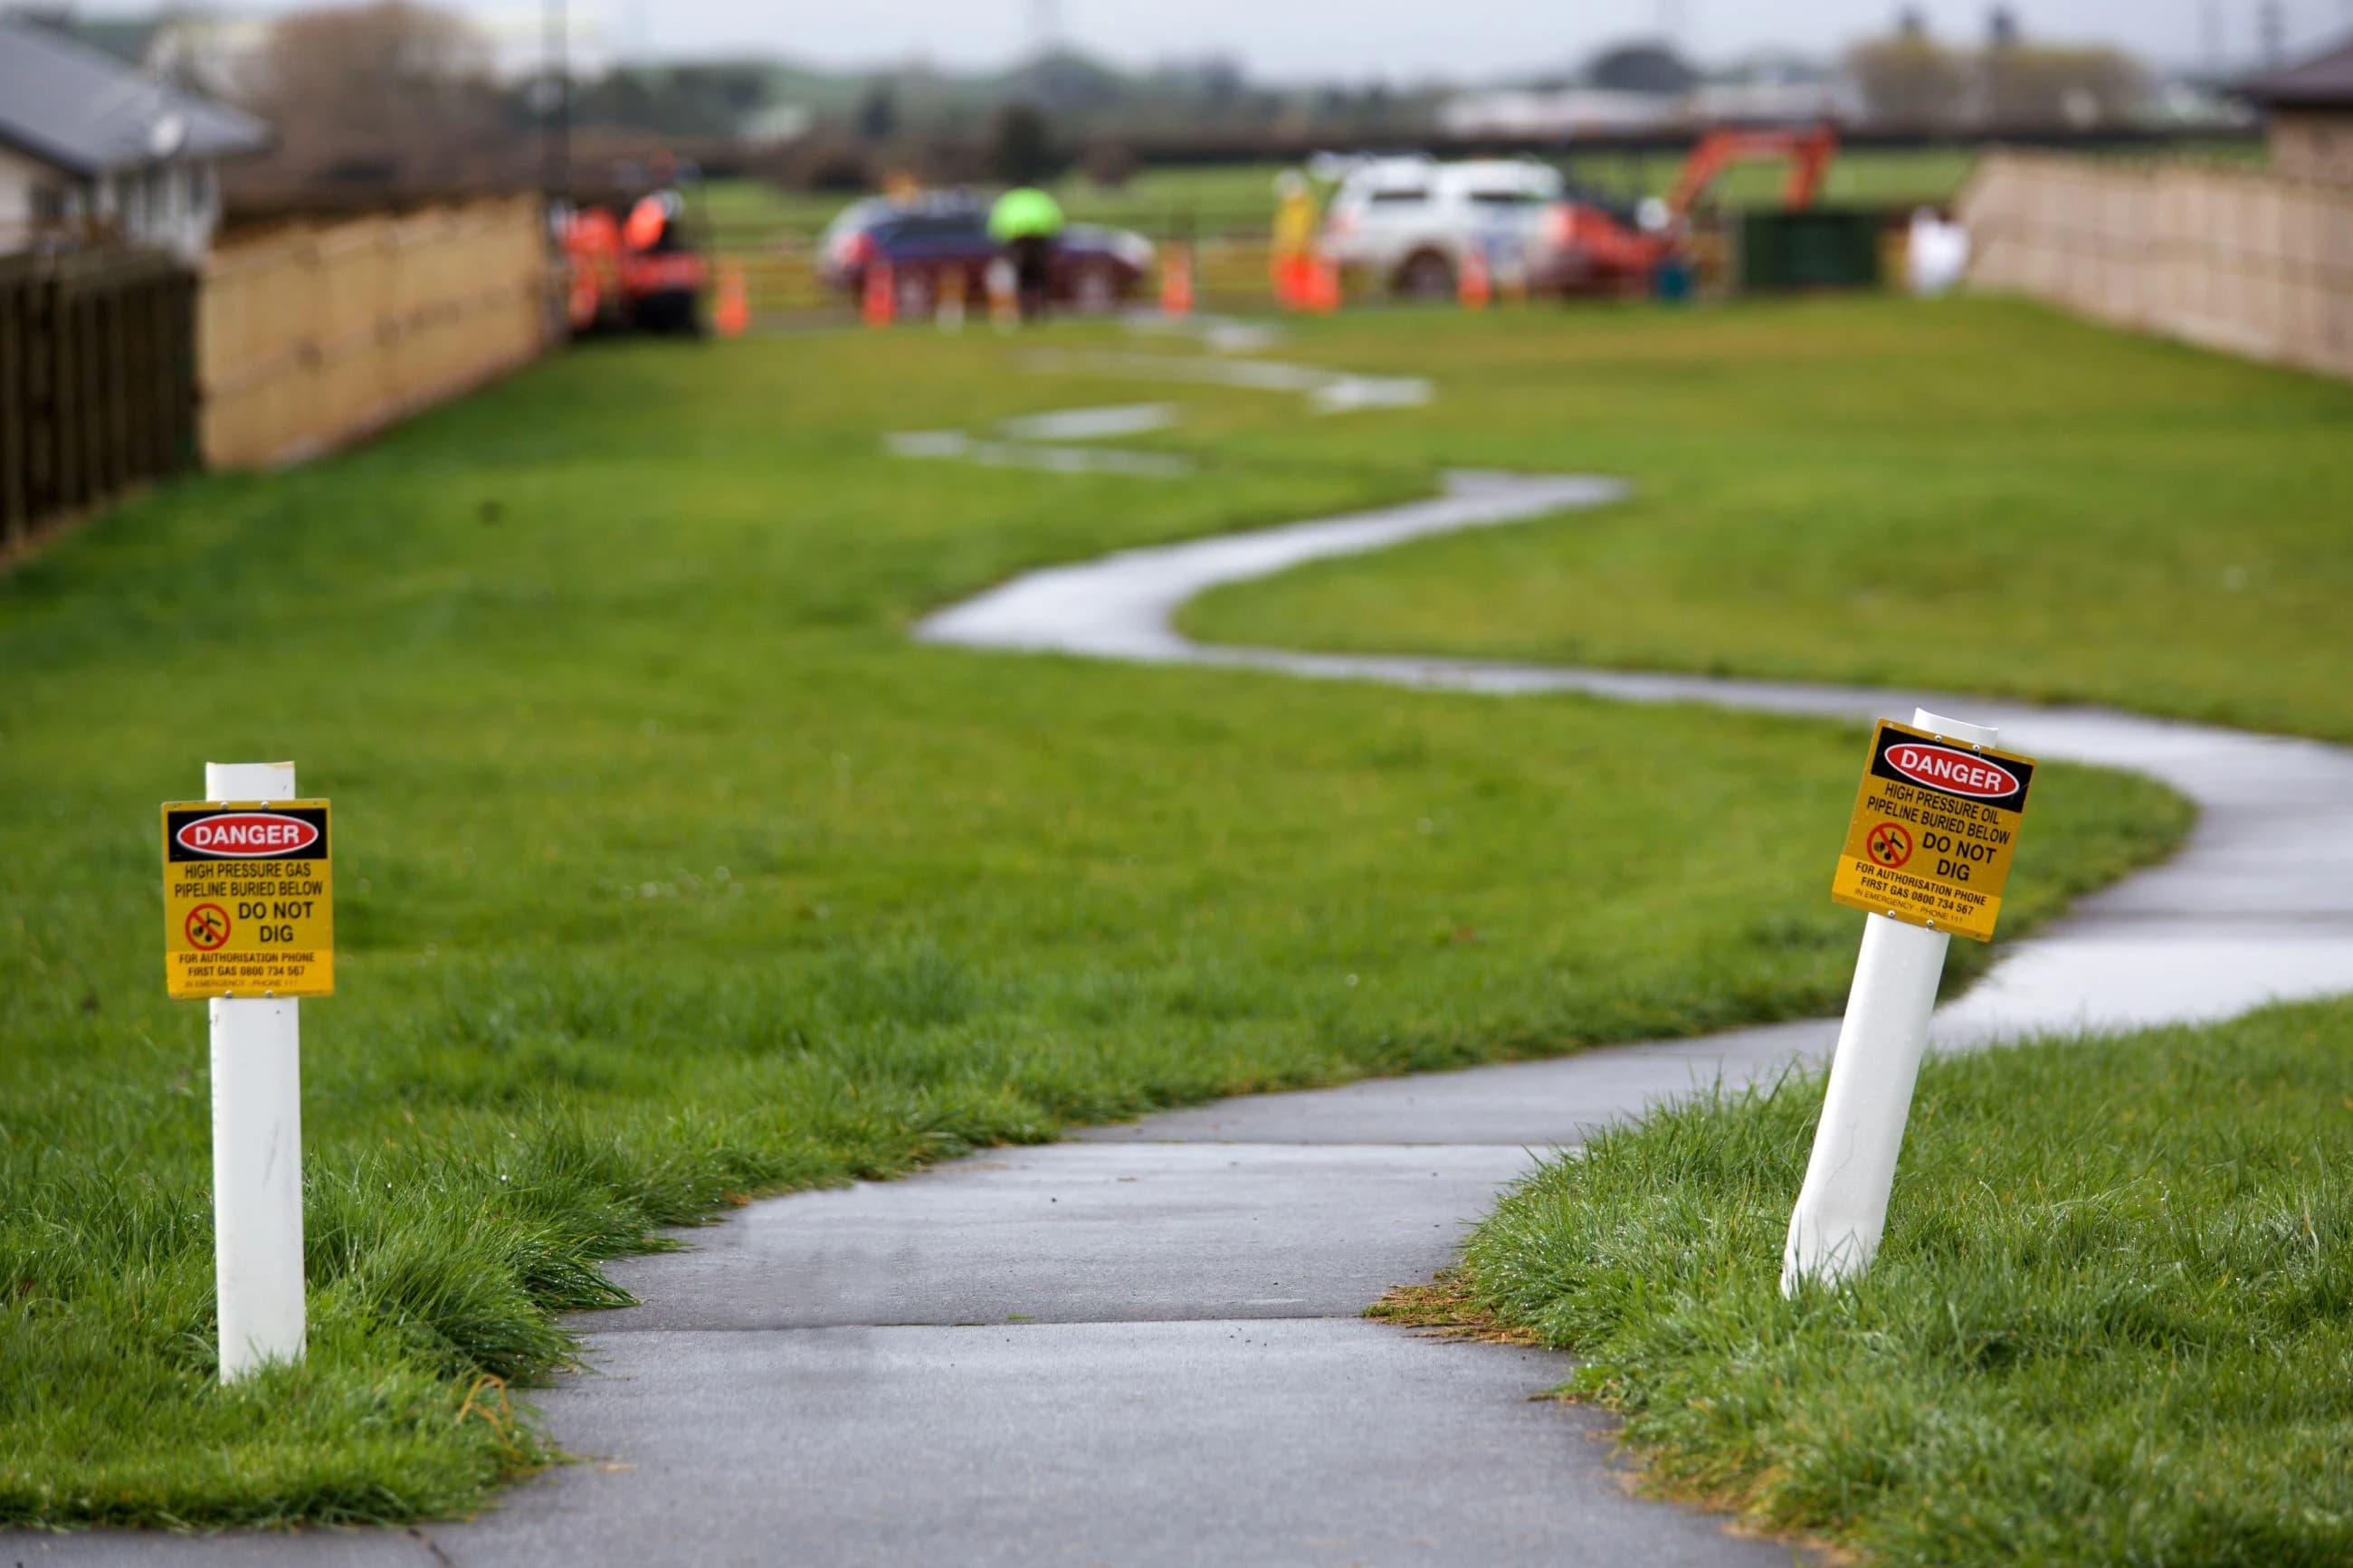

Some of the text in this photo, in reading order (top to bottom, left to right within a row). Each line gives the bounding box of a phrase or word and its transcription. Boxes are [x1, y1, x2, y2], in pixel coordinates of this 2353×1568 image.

[1901, 750, 2002, 792] DANGER
[1885, 783, 1998, 824] HIGH PRESSURE OIL
[1867, 796, 2011, 845] PIPELINE BURIED BELOW
[195, 826, 299, 845] DANGER
[1922, 832, 1996, 864] DO NOT
[185, 863, 311, 879] HIGH PRESSURE GAS
[1937, 859, 1970, 881] DIG
[175, 881, 323, 898] PIPELINE BURIED BELOW
[1856, 862, 1987, 906] FOR AUTHORISATION PHONE
[1861, 877, 1973, 915] FIRST GAS 0800 734 567
[1864, 891, 1914, 911] EMERGENCY
[1920, 906, 1948, 919] PHONE
[1951, 914, 1962, 923] 111
[238, 902, 313, 919] DO NOT
[260, 926, 293, 942] DIG
[179, 953, 314, 963] FOR AUTHORISATION PHONE
[188, 966, 304, 976] FIRST GAS 0800 734 567
